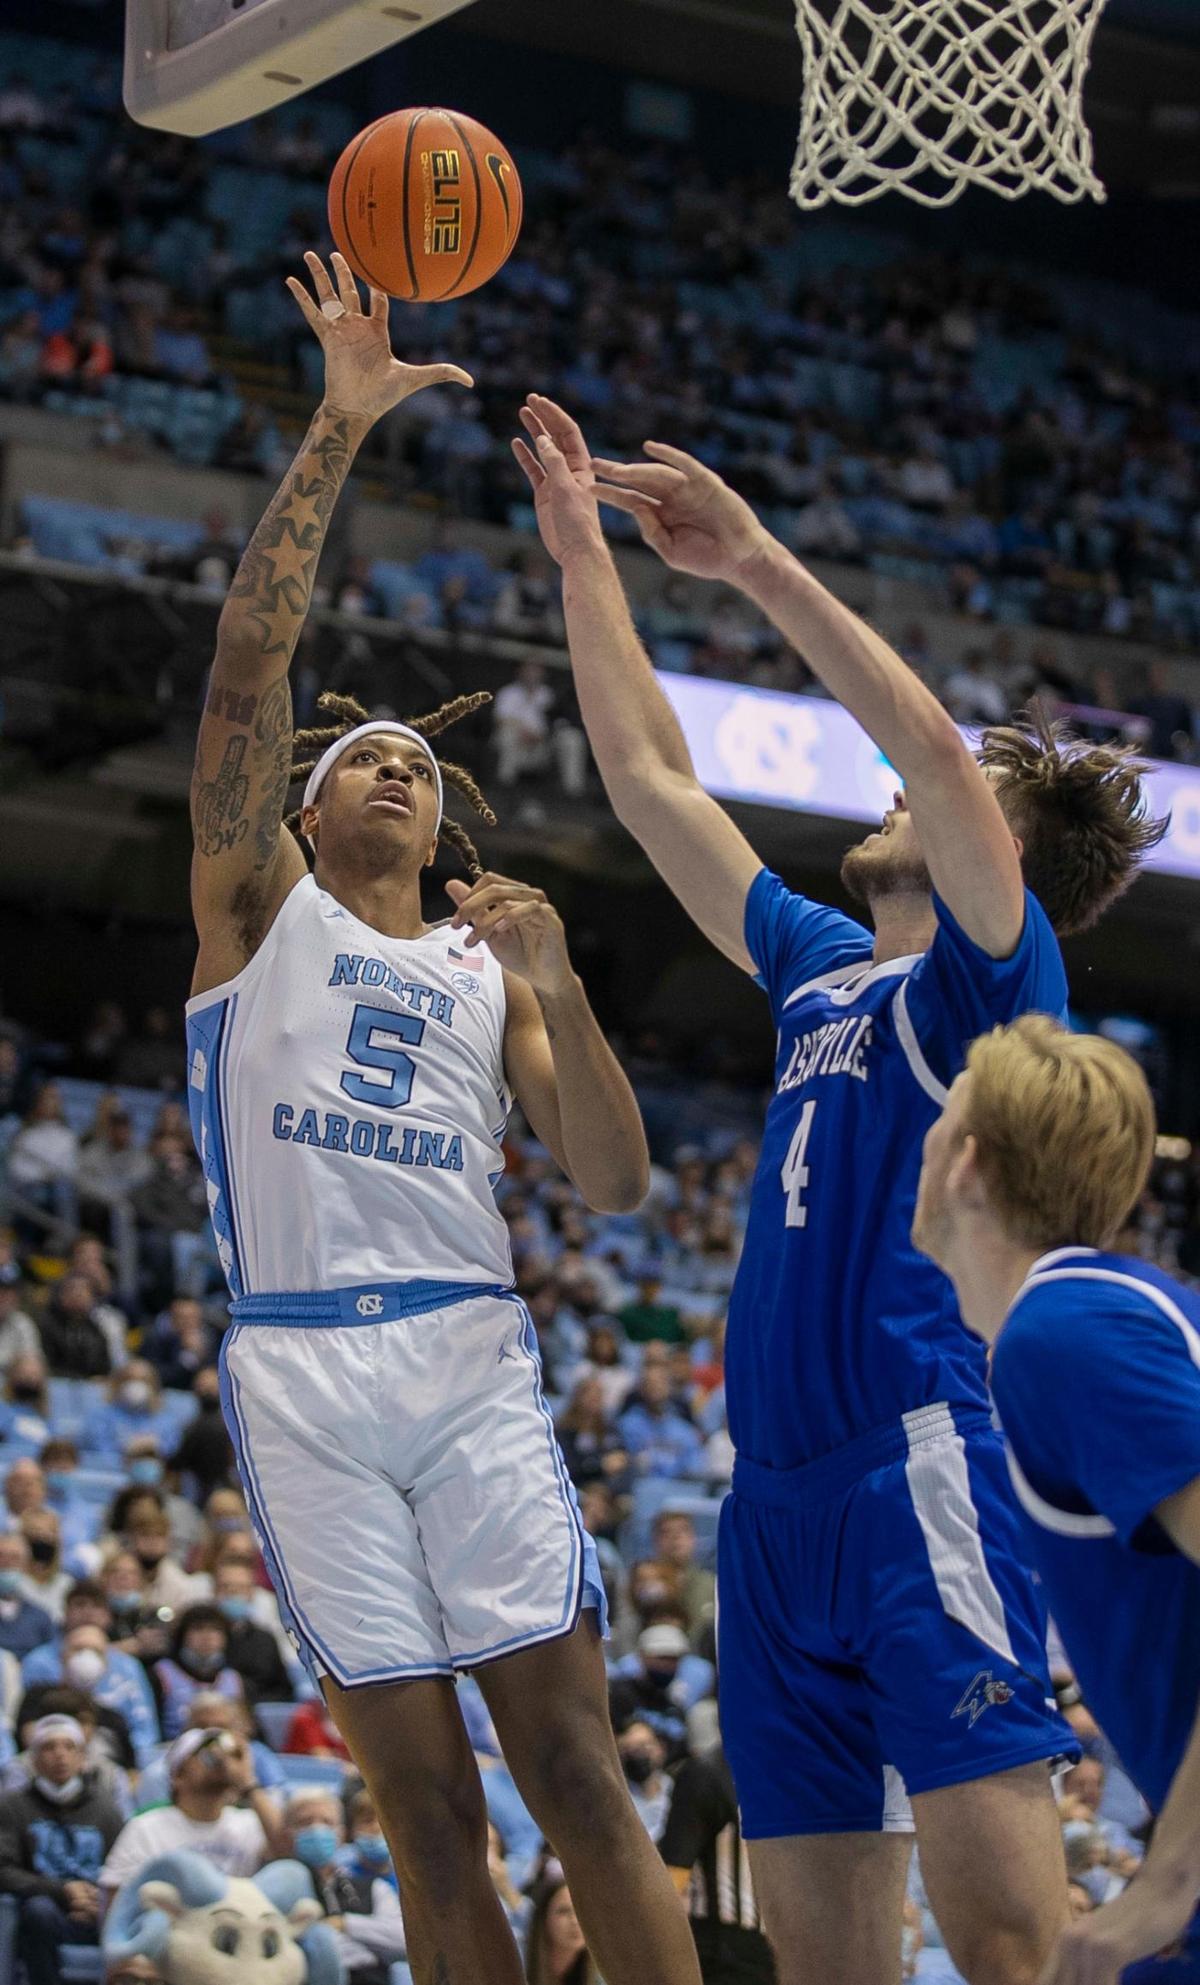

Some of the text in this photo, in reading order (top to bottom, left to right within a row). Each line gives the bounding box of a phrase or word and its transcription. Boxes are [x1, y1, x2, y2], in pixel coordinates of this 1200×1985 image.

[430, 149, 461, 255] ELITE
[328, 953, 456, 1029] NORTH
[339, 1003, 427, 1109] 5
[272, 1102, 465, 1172] CAROLINA
[780, 1099, 817, 1228] 4
